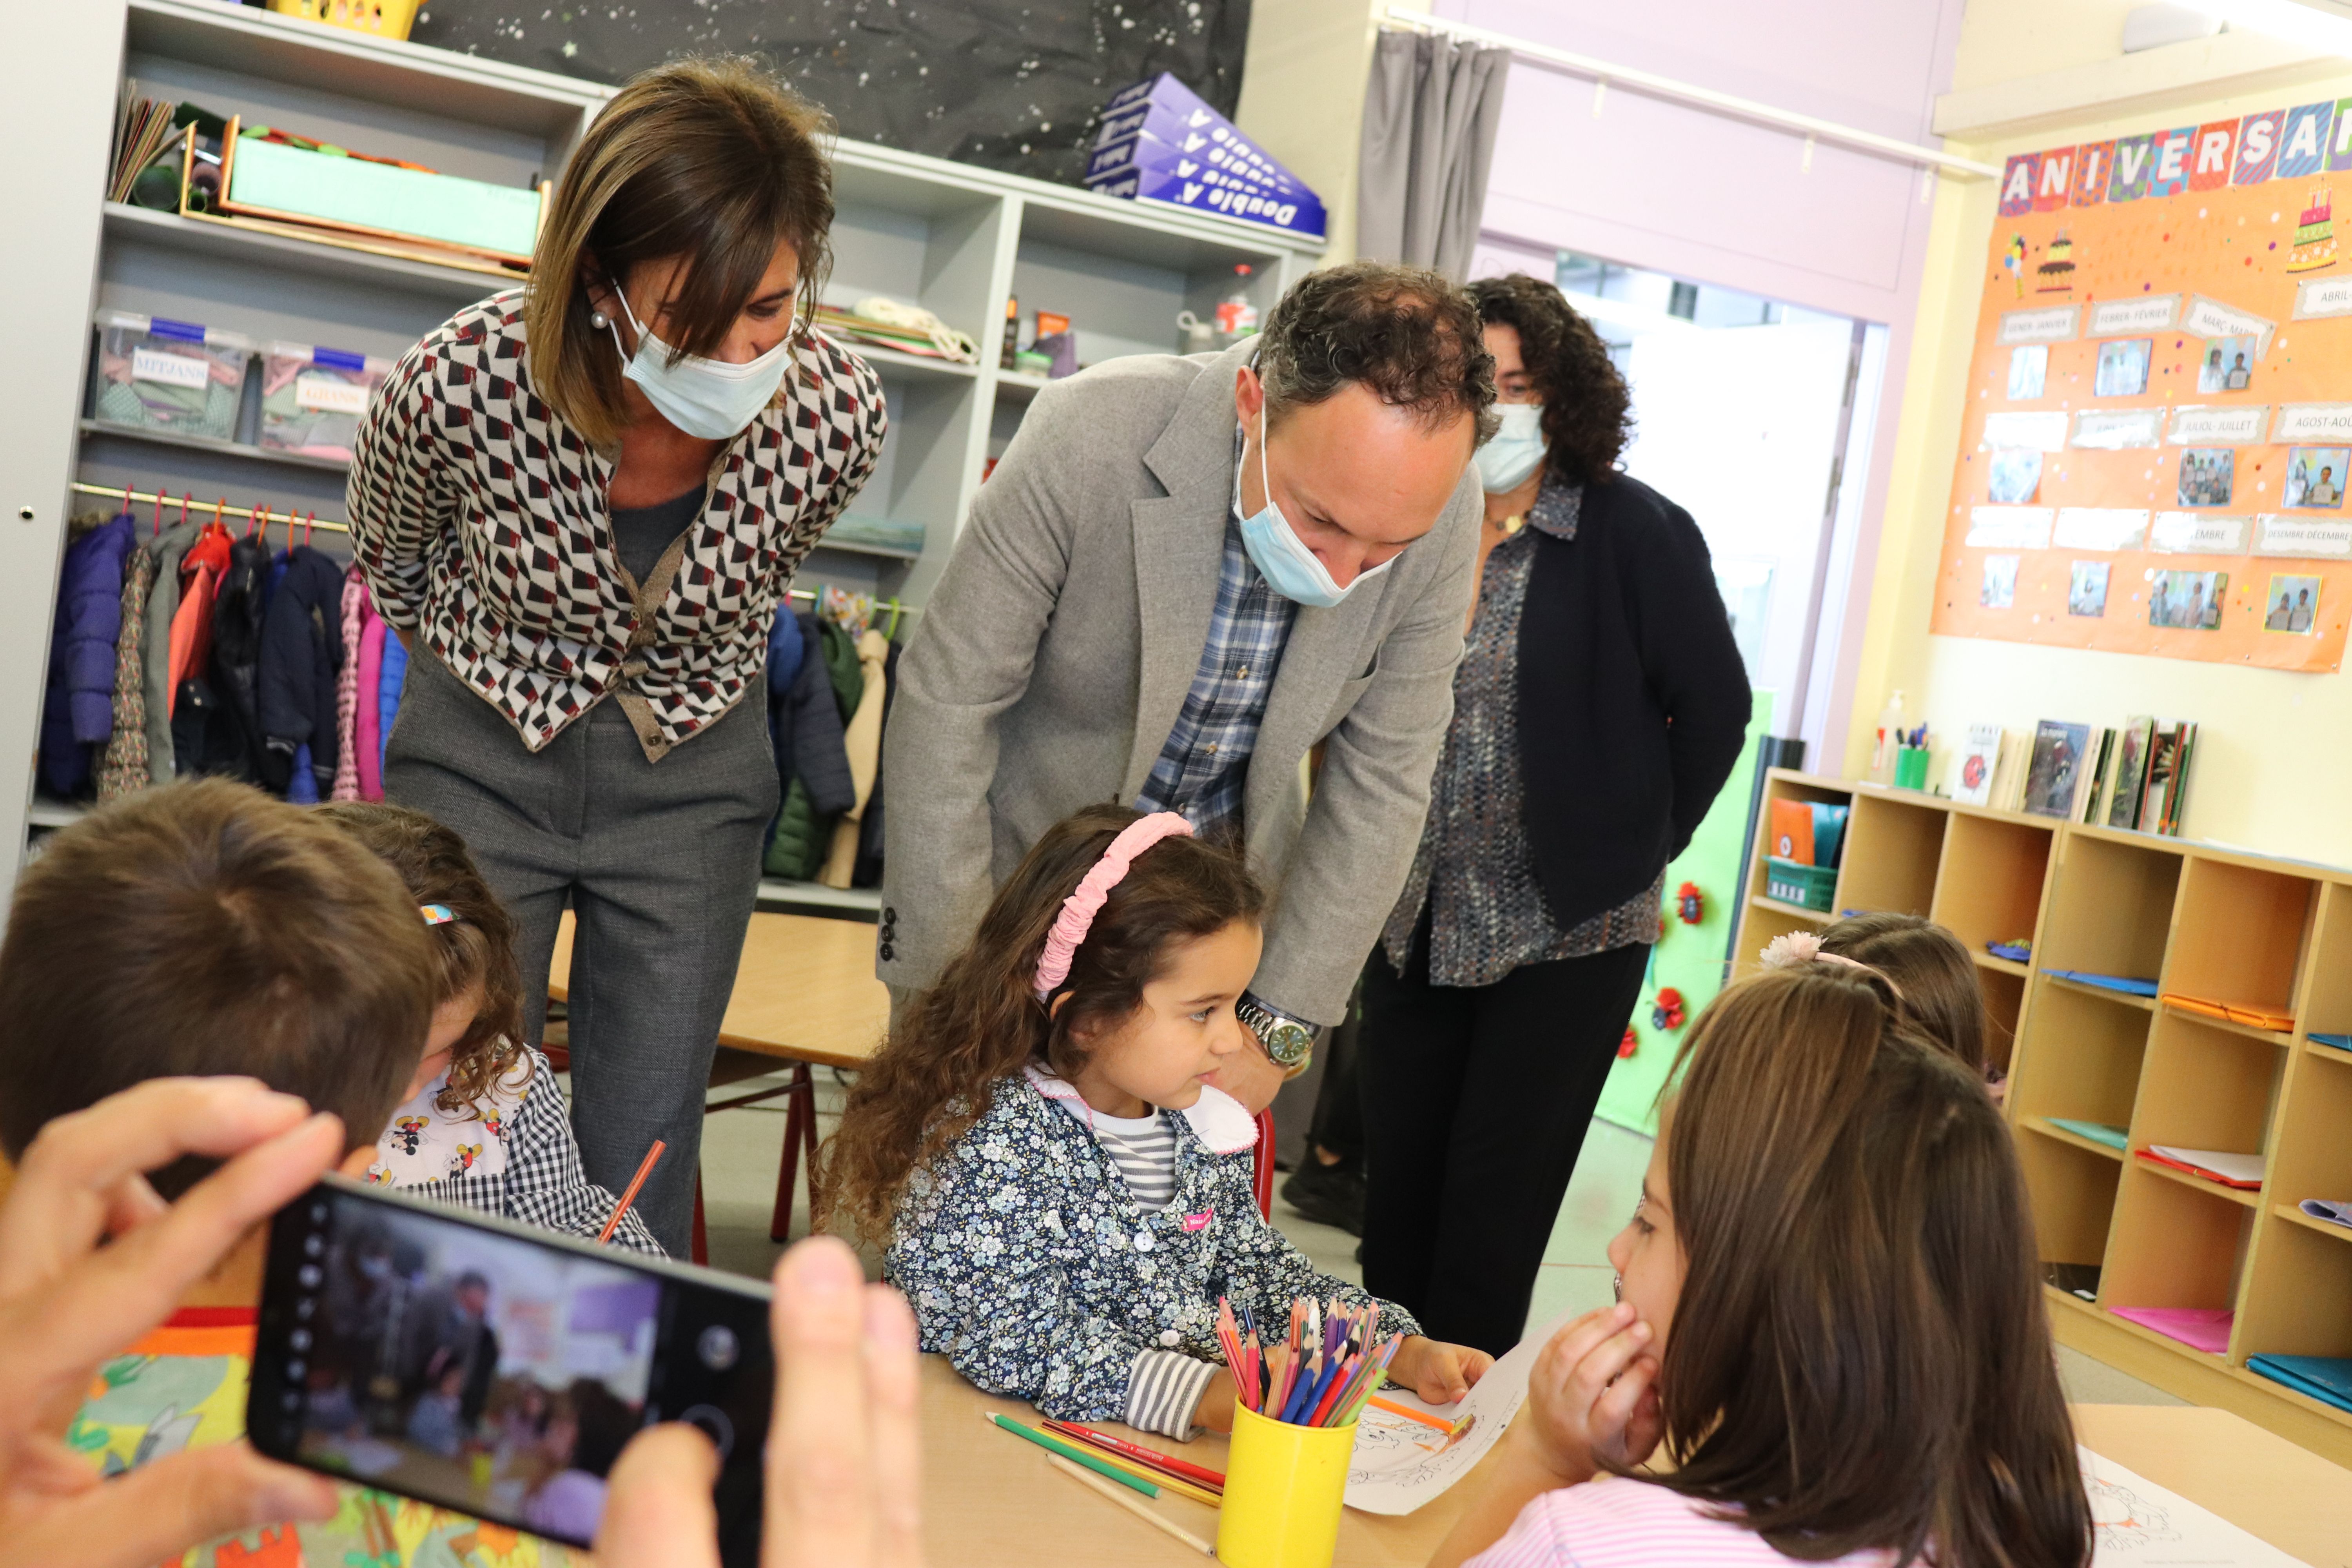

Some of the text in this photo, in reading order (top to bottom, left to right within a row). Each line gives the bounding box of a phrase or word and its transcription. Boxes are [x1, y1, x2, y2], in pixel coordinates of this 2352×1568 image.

[1183, 132, 1207, 153] A
[1177, 158, 1199, 178] A
[1181, 181, 1204, 204] A
[136, 356, 205, 379] MITJANS
[2218, 420, 2252, 431] JUILLET
